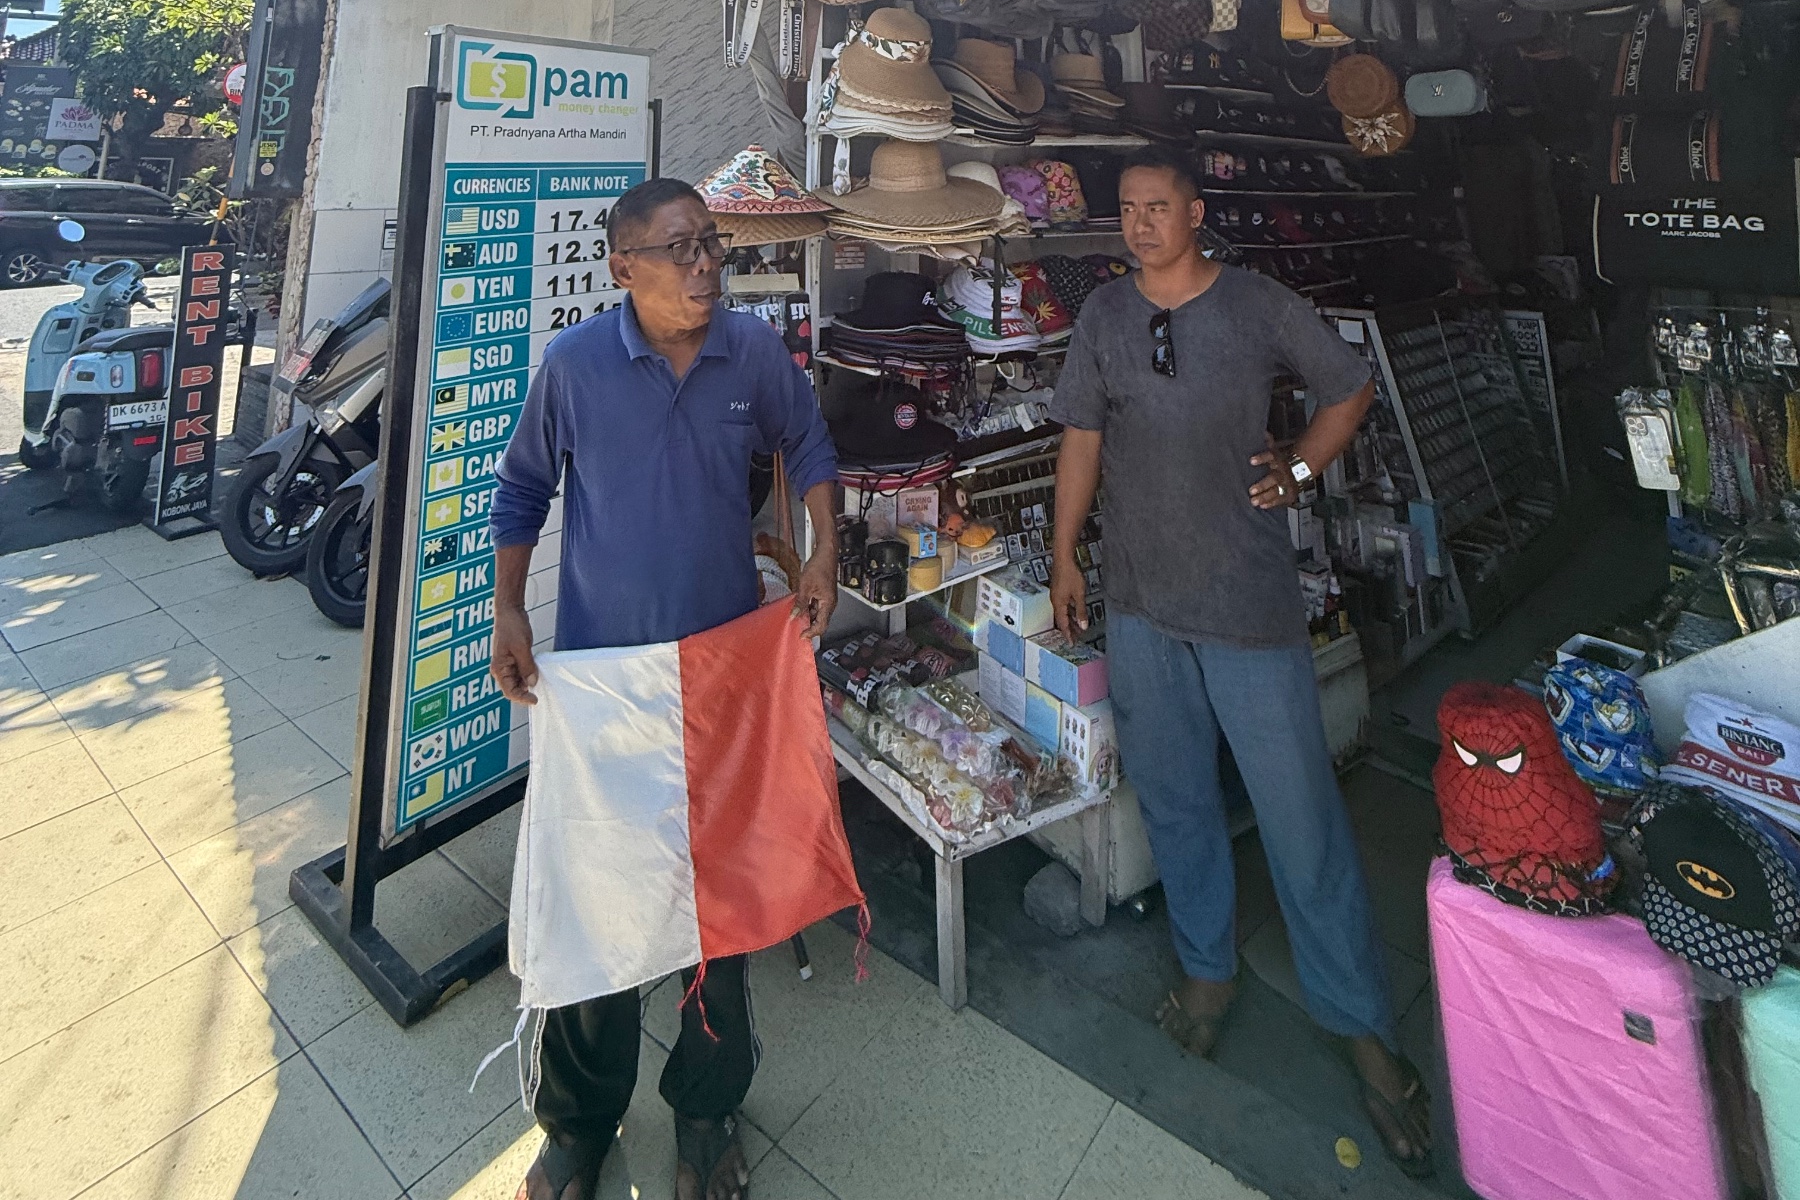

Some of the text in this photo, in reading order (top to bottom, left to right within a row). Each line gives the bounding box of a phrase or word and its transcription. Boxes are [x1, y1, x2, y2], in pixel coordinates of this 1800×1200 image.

[738, 41, 750, 61] Dior
[543, 67, 628, 107] pam
[558, 102, 639, 116] money changer
[55, 121, 94, 129] PADMA
[470, 126, 626, 140] PT. Pradnyana Artha Mandiri
[453, 176, 629, 195] CURRENCIES BANK NOTE
[1671, 198, 1717, 209] THE
[482, 208, 520, 230] USD
[1624, 212, 1765, 232] TOTE BAG
[1687, 231, 1721, 239] JACOBS
[478, 242, 518, 265] AUD
[186, 252, 225, 345] RENT
[477, 275, 515, 300] YEN
[475, 307, 528, 335] EURO
[473, 344, 513, 371] SGD
[471, 378, 517, 407] MYR
[113, 406, 127, 417] DK
[130, 403, 157, 414] 6673
[174, 365, 214, 466] BIKE
[469, 414, 511, 443] GBP
[466, 450, 503, 480] CA
[192, 499, 208, 510] JAYA
[905, 496, 932, 504] CRYING
[461, 527, 495, 555] NZ
[459, 562, 490, 594] HK
[450, 707, 500, 751] WON
[1722, 727, 1781, 754] BINTANG
[1737, 746, 1765, 761] BALI
[447, 757, 477, 794] NT
